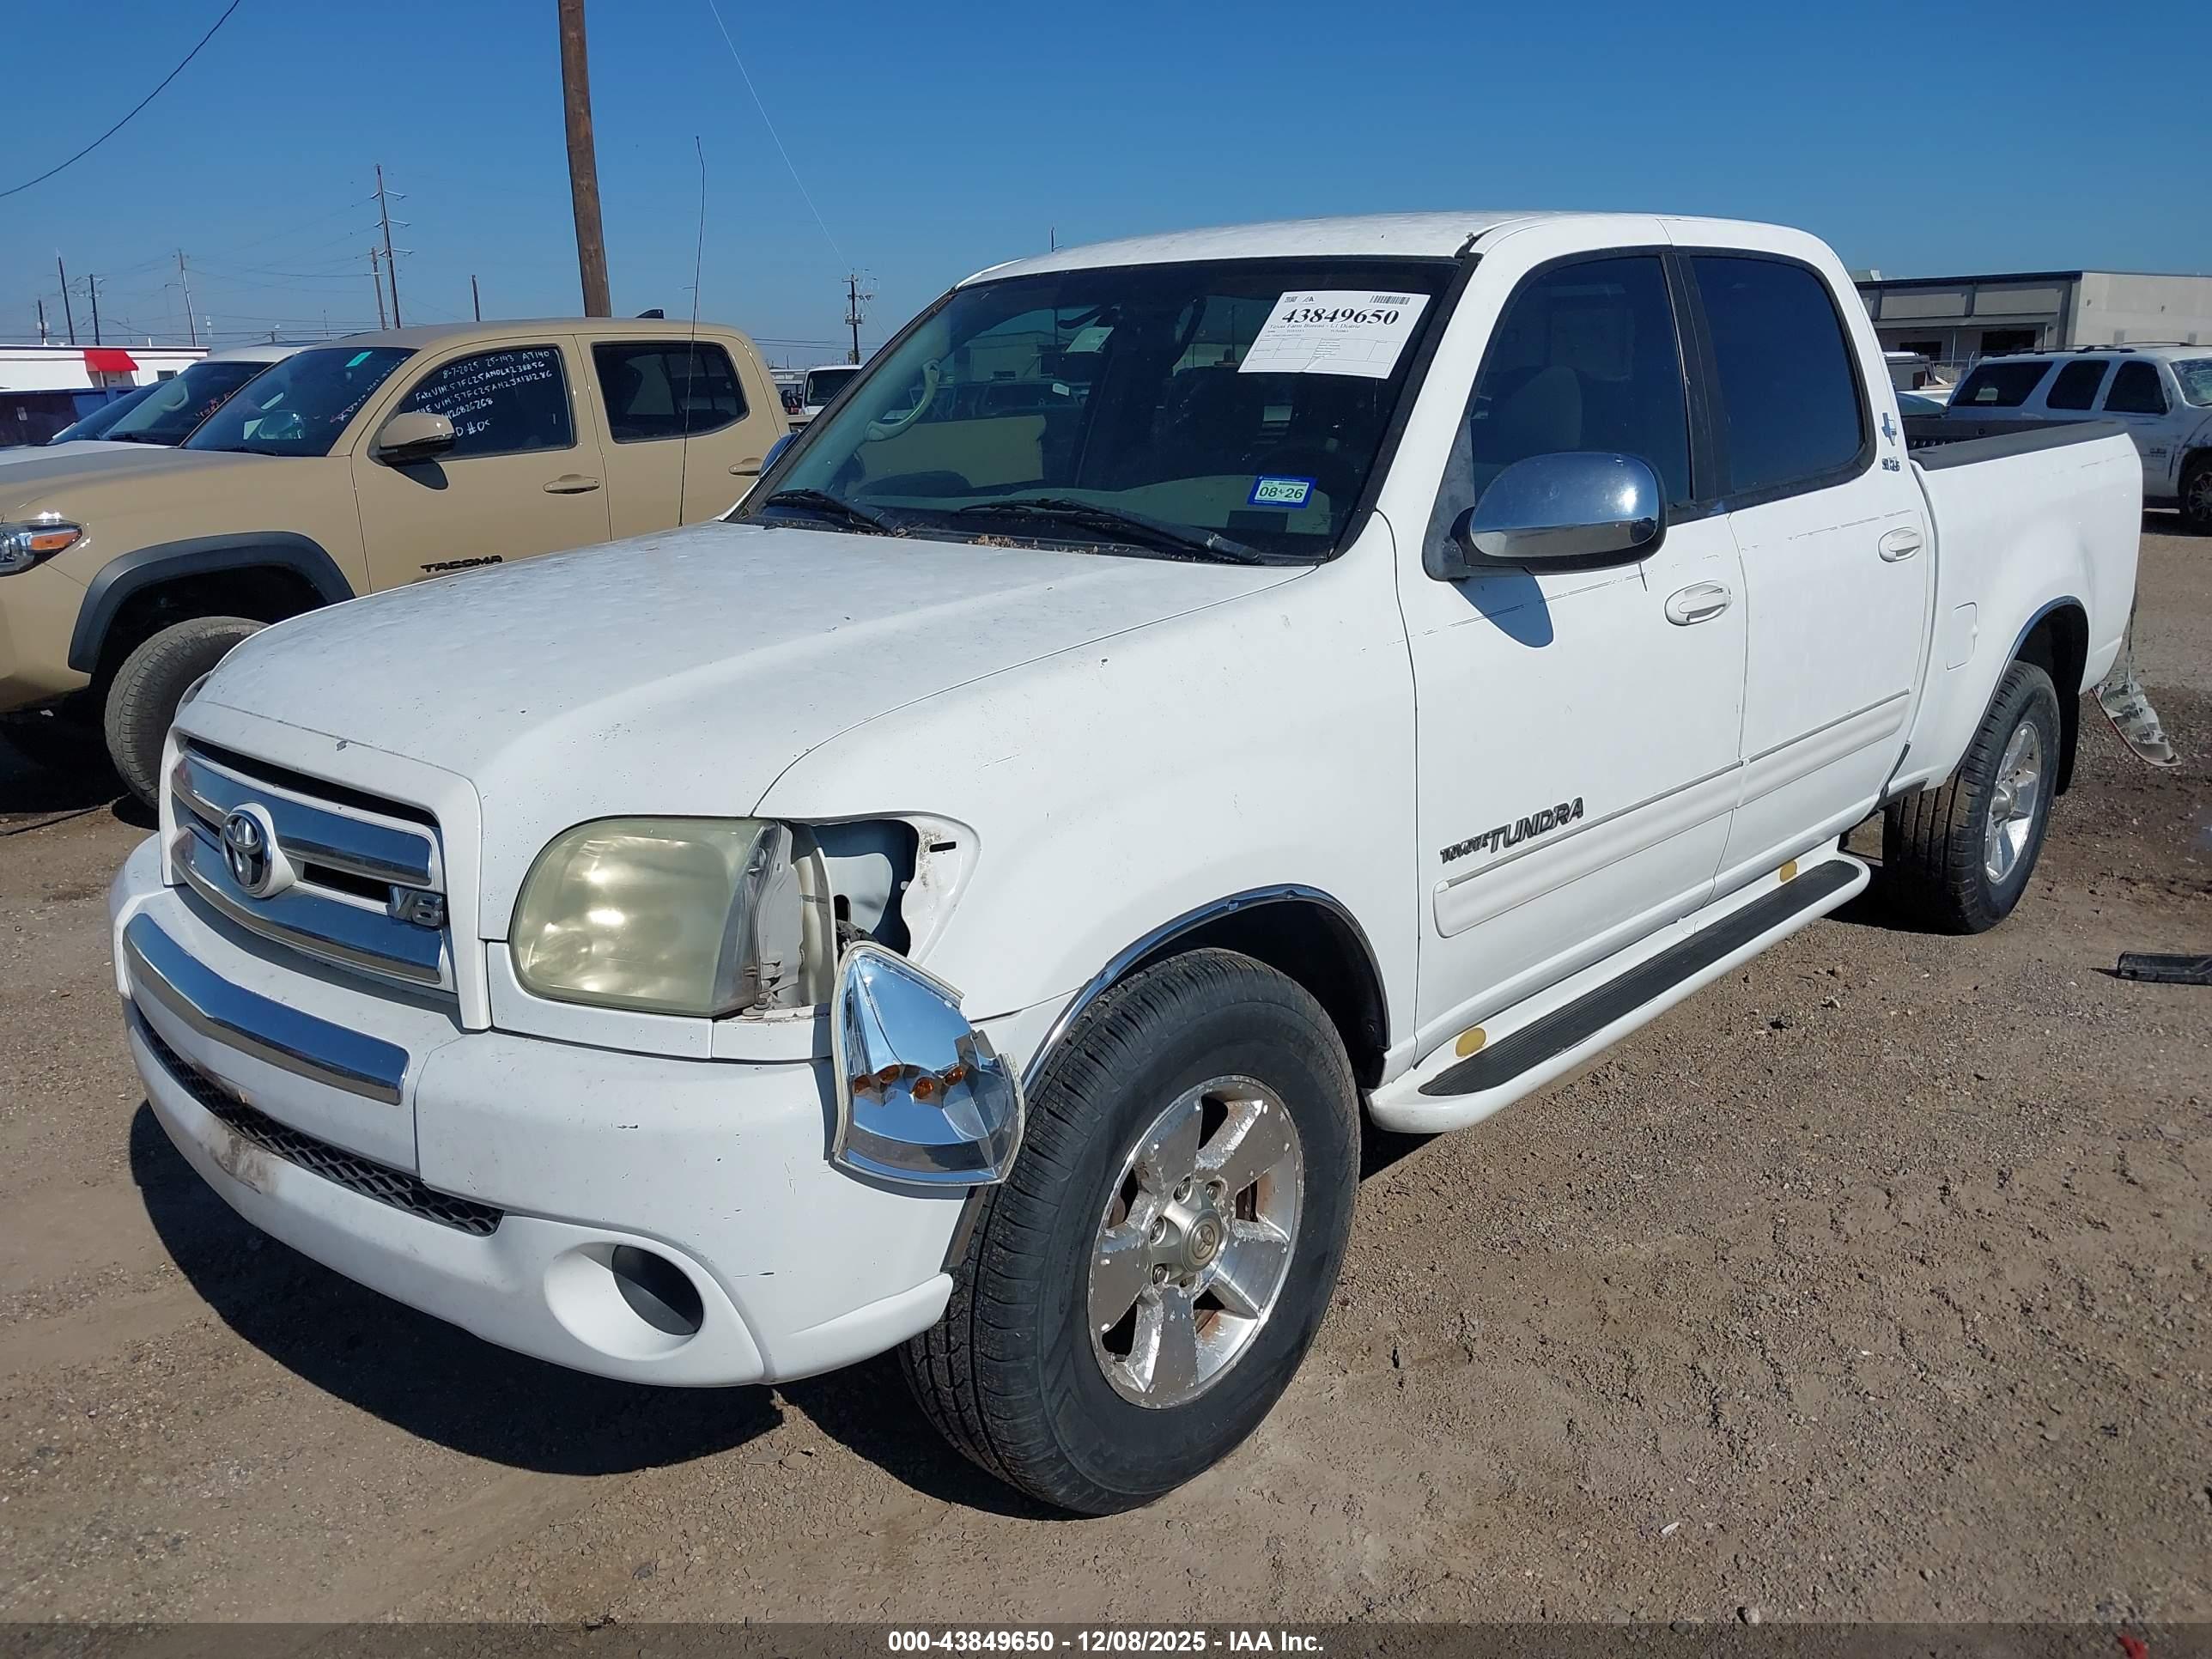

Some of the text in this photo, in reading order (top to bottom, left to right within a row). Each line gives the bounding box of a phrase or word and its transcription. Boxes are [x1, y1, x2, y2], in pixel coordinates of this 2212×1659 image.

[1282, 308, 1400, 325] 43849650
[442, 361, 479, 379] 8-7-2025
[485, 354, 515, 367] 25-143
[420, 555, 503, 573] TACOMA
[1488, 797, 1584, 854] TUNDRA
[390, 885, 443, 927] V8
